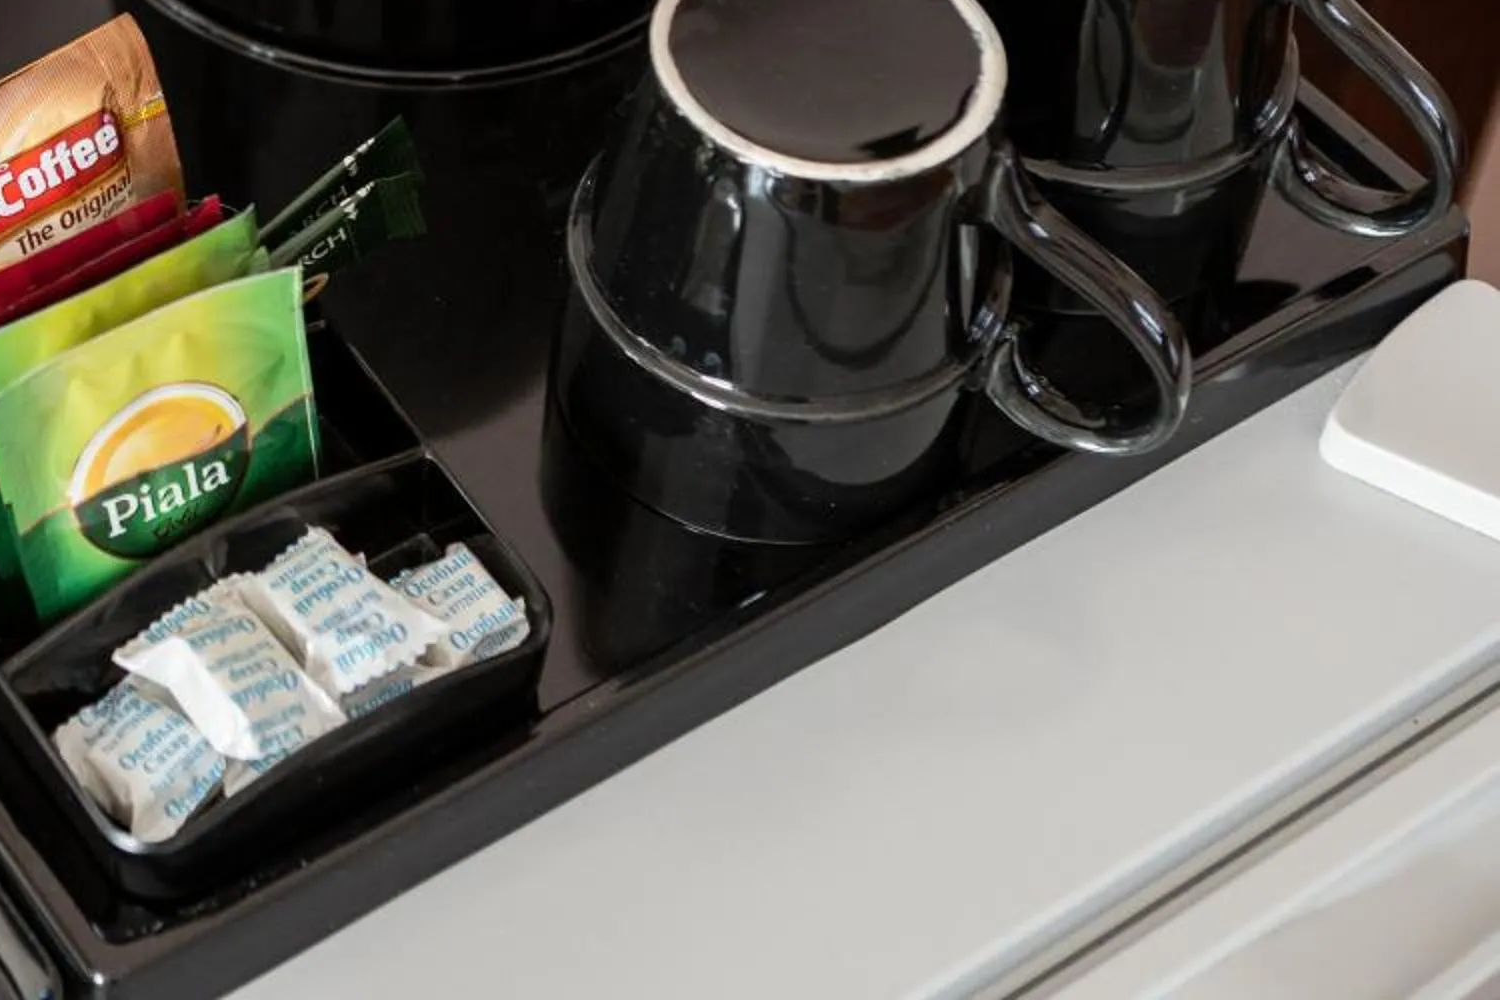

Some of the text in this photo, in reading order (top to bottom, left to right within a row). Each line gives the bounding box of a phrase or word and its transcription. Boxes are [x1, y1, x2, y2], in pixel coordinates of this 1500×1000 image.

[15, 222, 55, 255] The
[59, 164, 132, 230] Original
[101, 460, 232, 539] Piala
